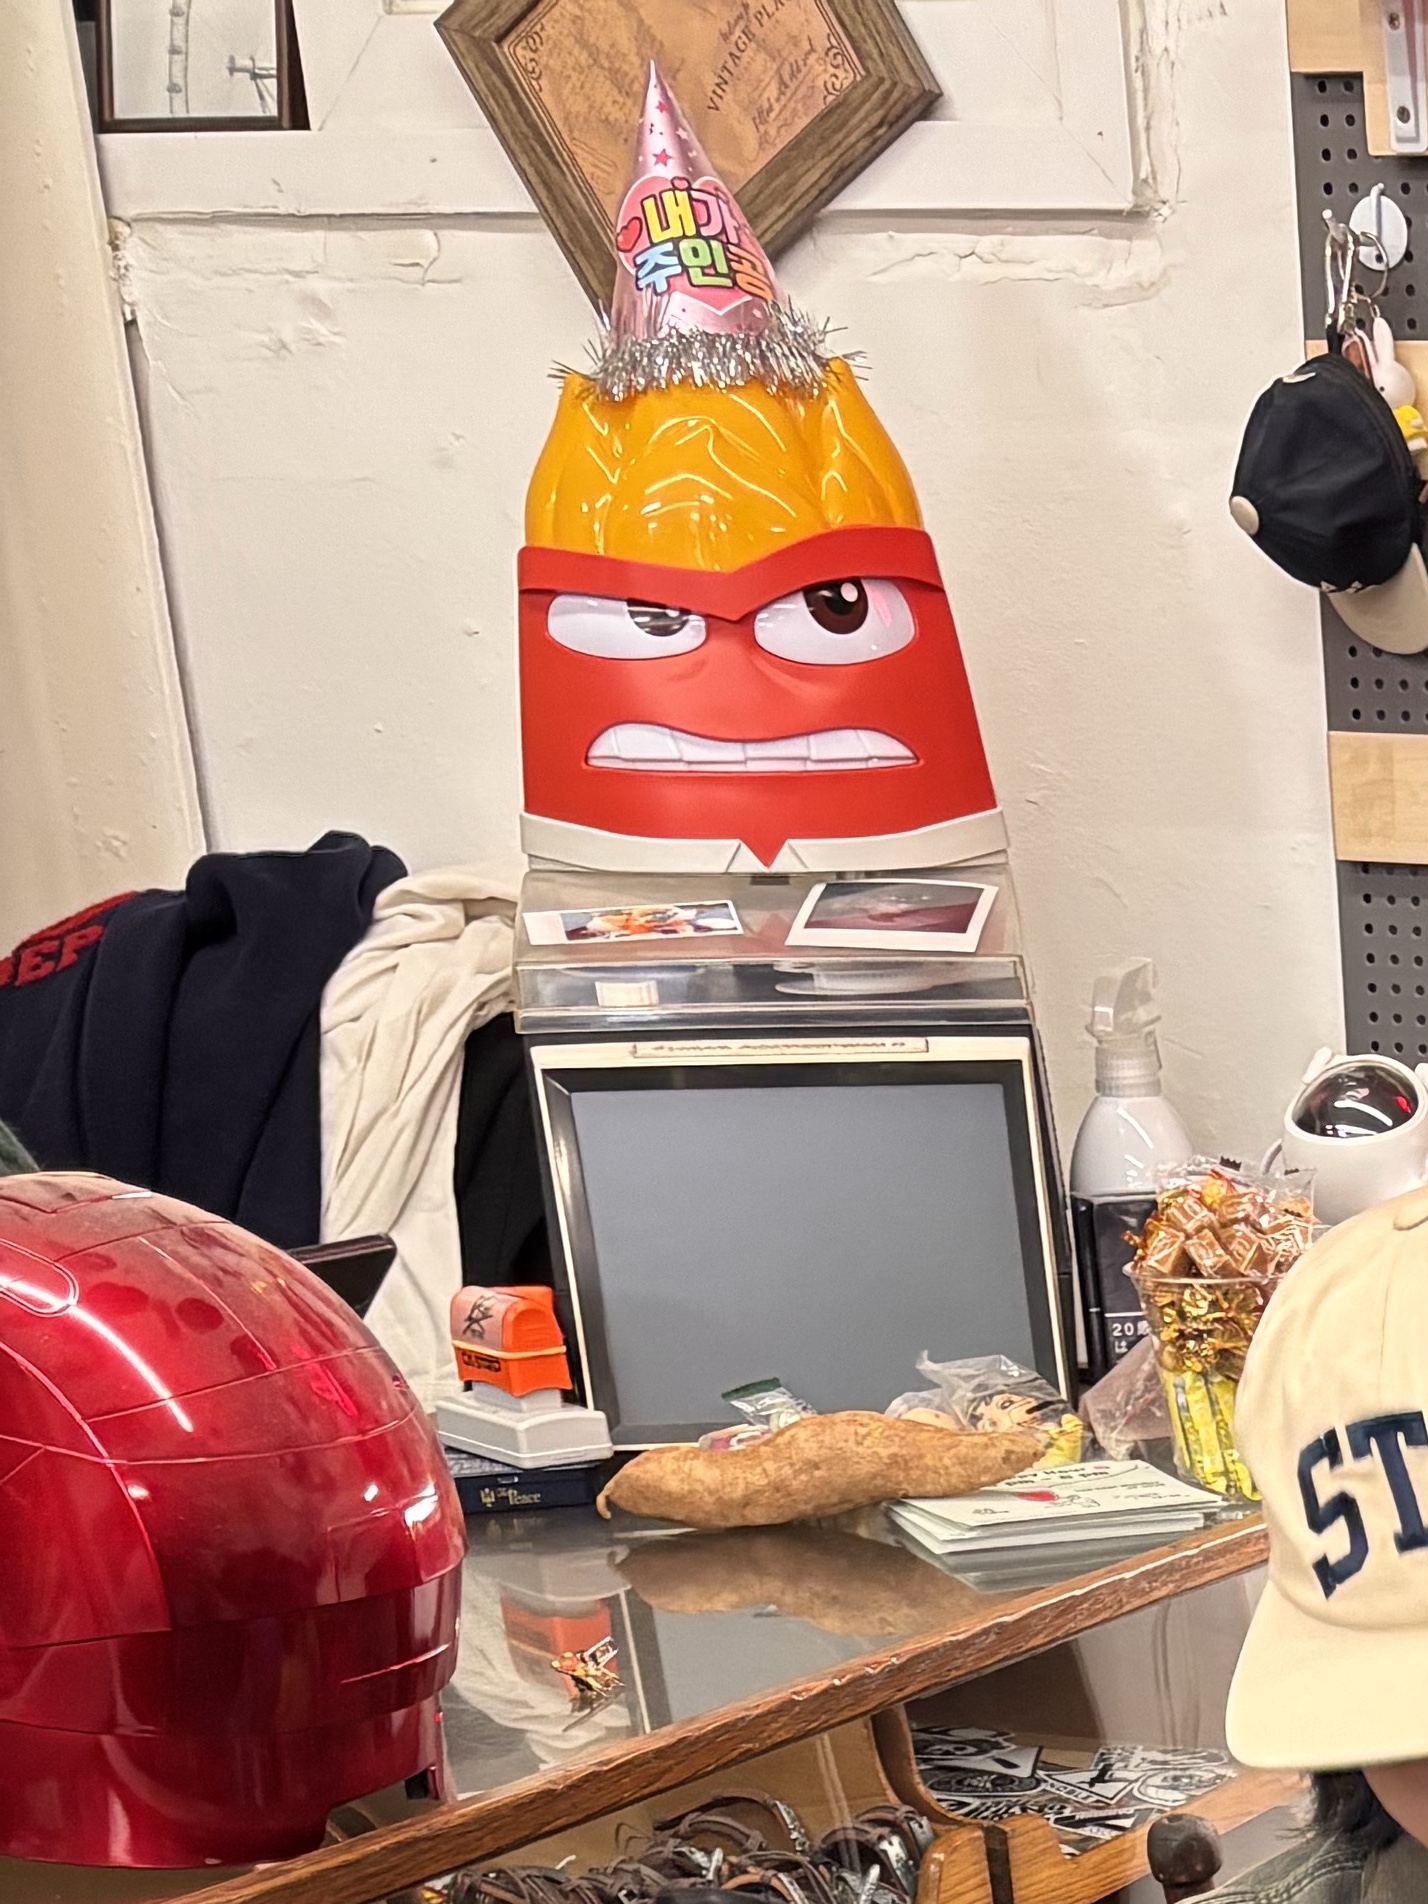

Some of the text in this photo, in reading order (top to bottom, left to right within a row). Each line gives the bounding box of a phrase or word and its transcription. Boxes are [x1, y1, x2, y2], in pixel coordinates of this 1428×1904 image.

[707, 27, 756, 113] VINTAGE
[641, 187, 740, 245] 내가
[633, 237, 775, 301] 주인공
[508, 1488, 542, 1505] Peace
